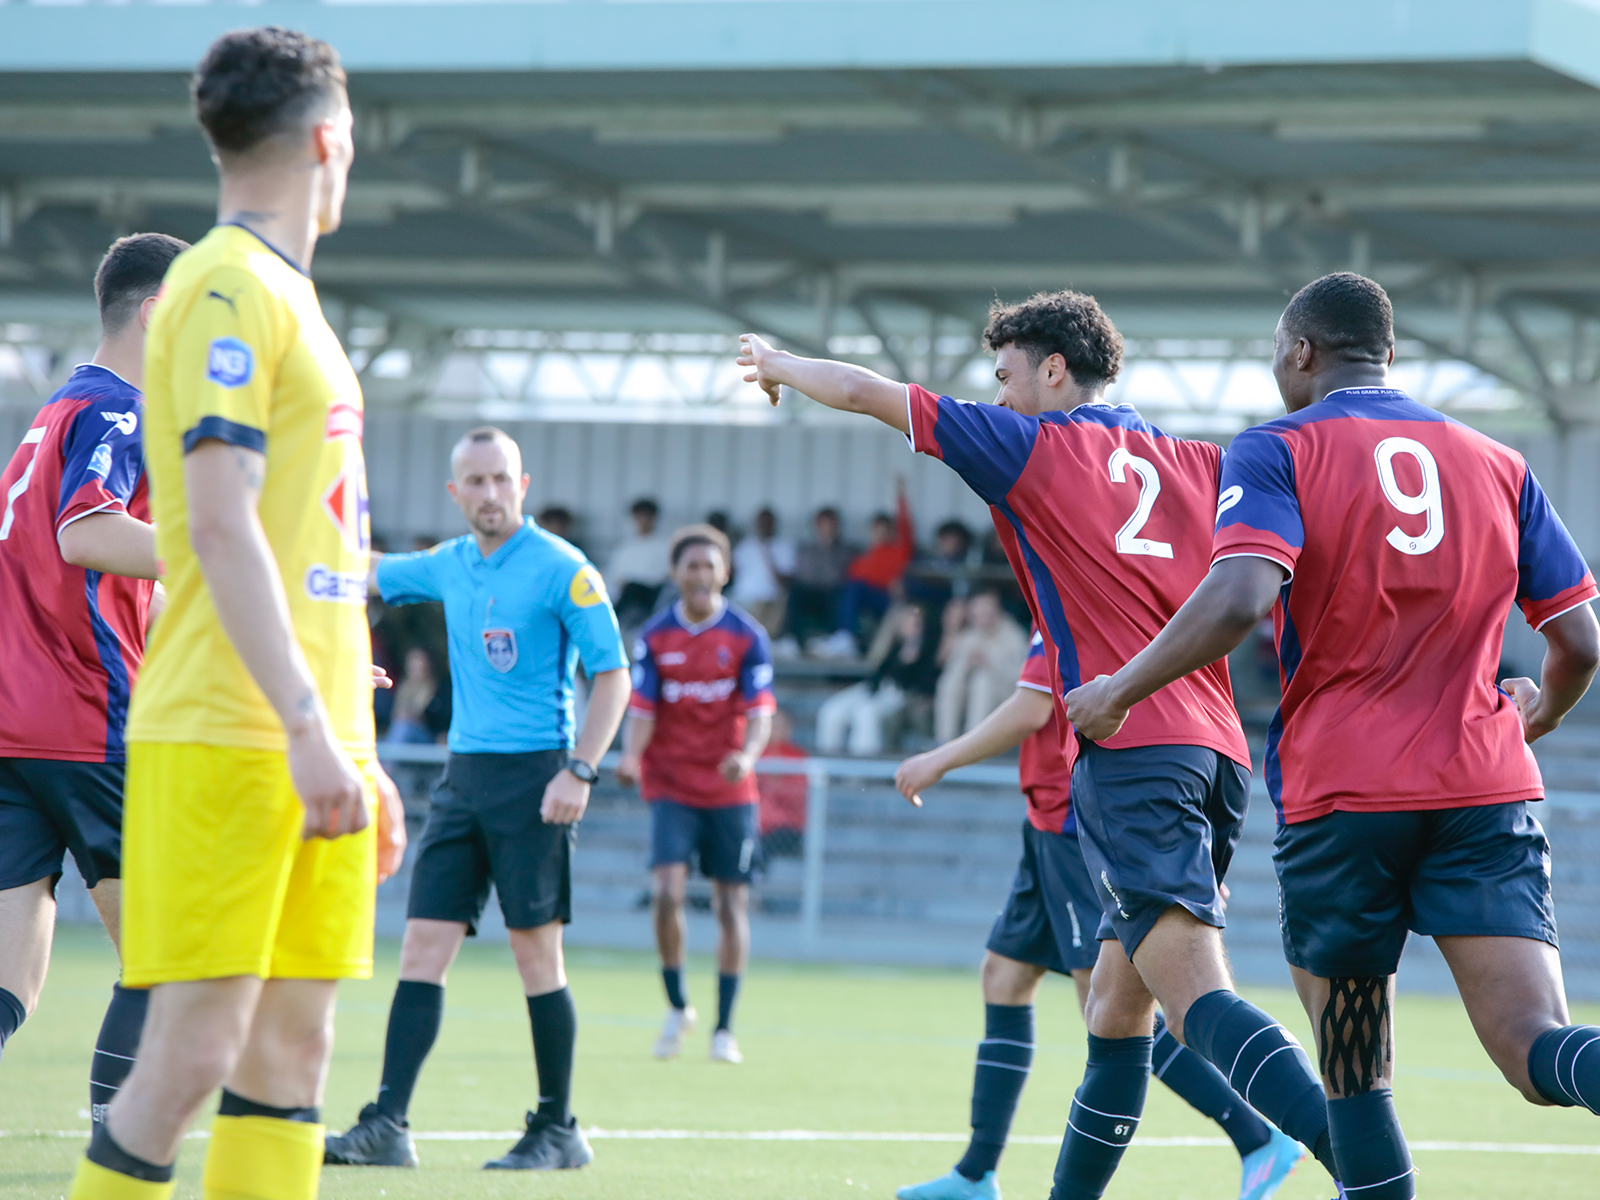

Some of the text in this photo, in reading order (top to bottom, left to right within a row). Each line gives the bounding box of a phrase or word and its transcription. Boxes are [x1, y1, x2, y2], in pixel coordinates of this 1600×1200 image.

[211, 348, 248, 376] N3
[0, 426, 48, 540] 7
[1108, 447, 1174, 559] 2
[1374, 437, 1445, 555] 9
